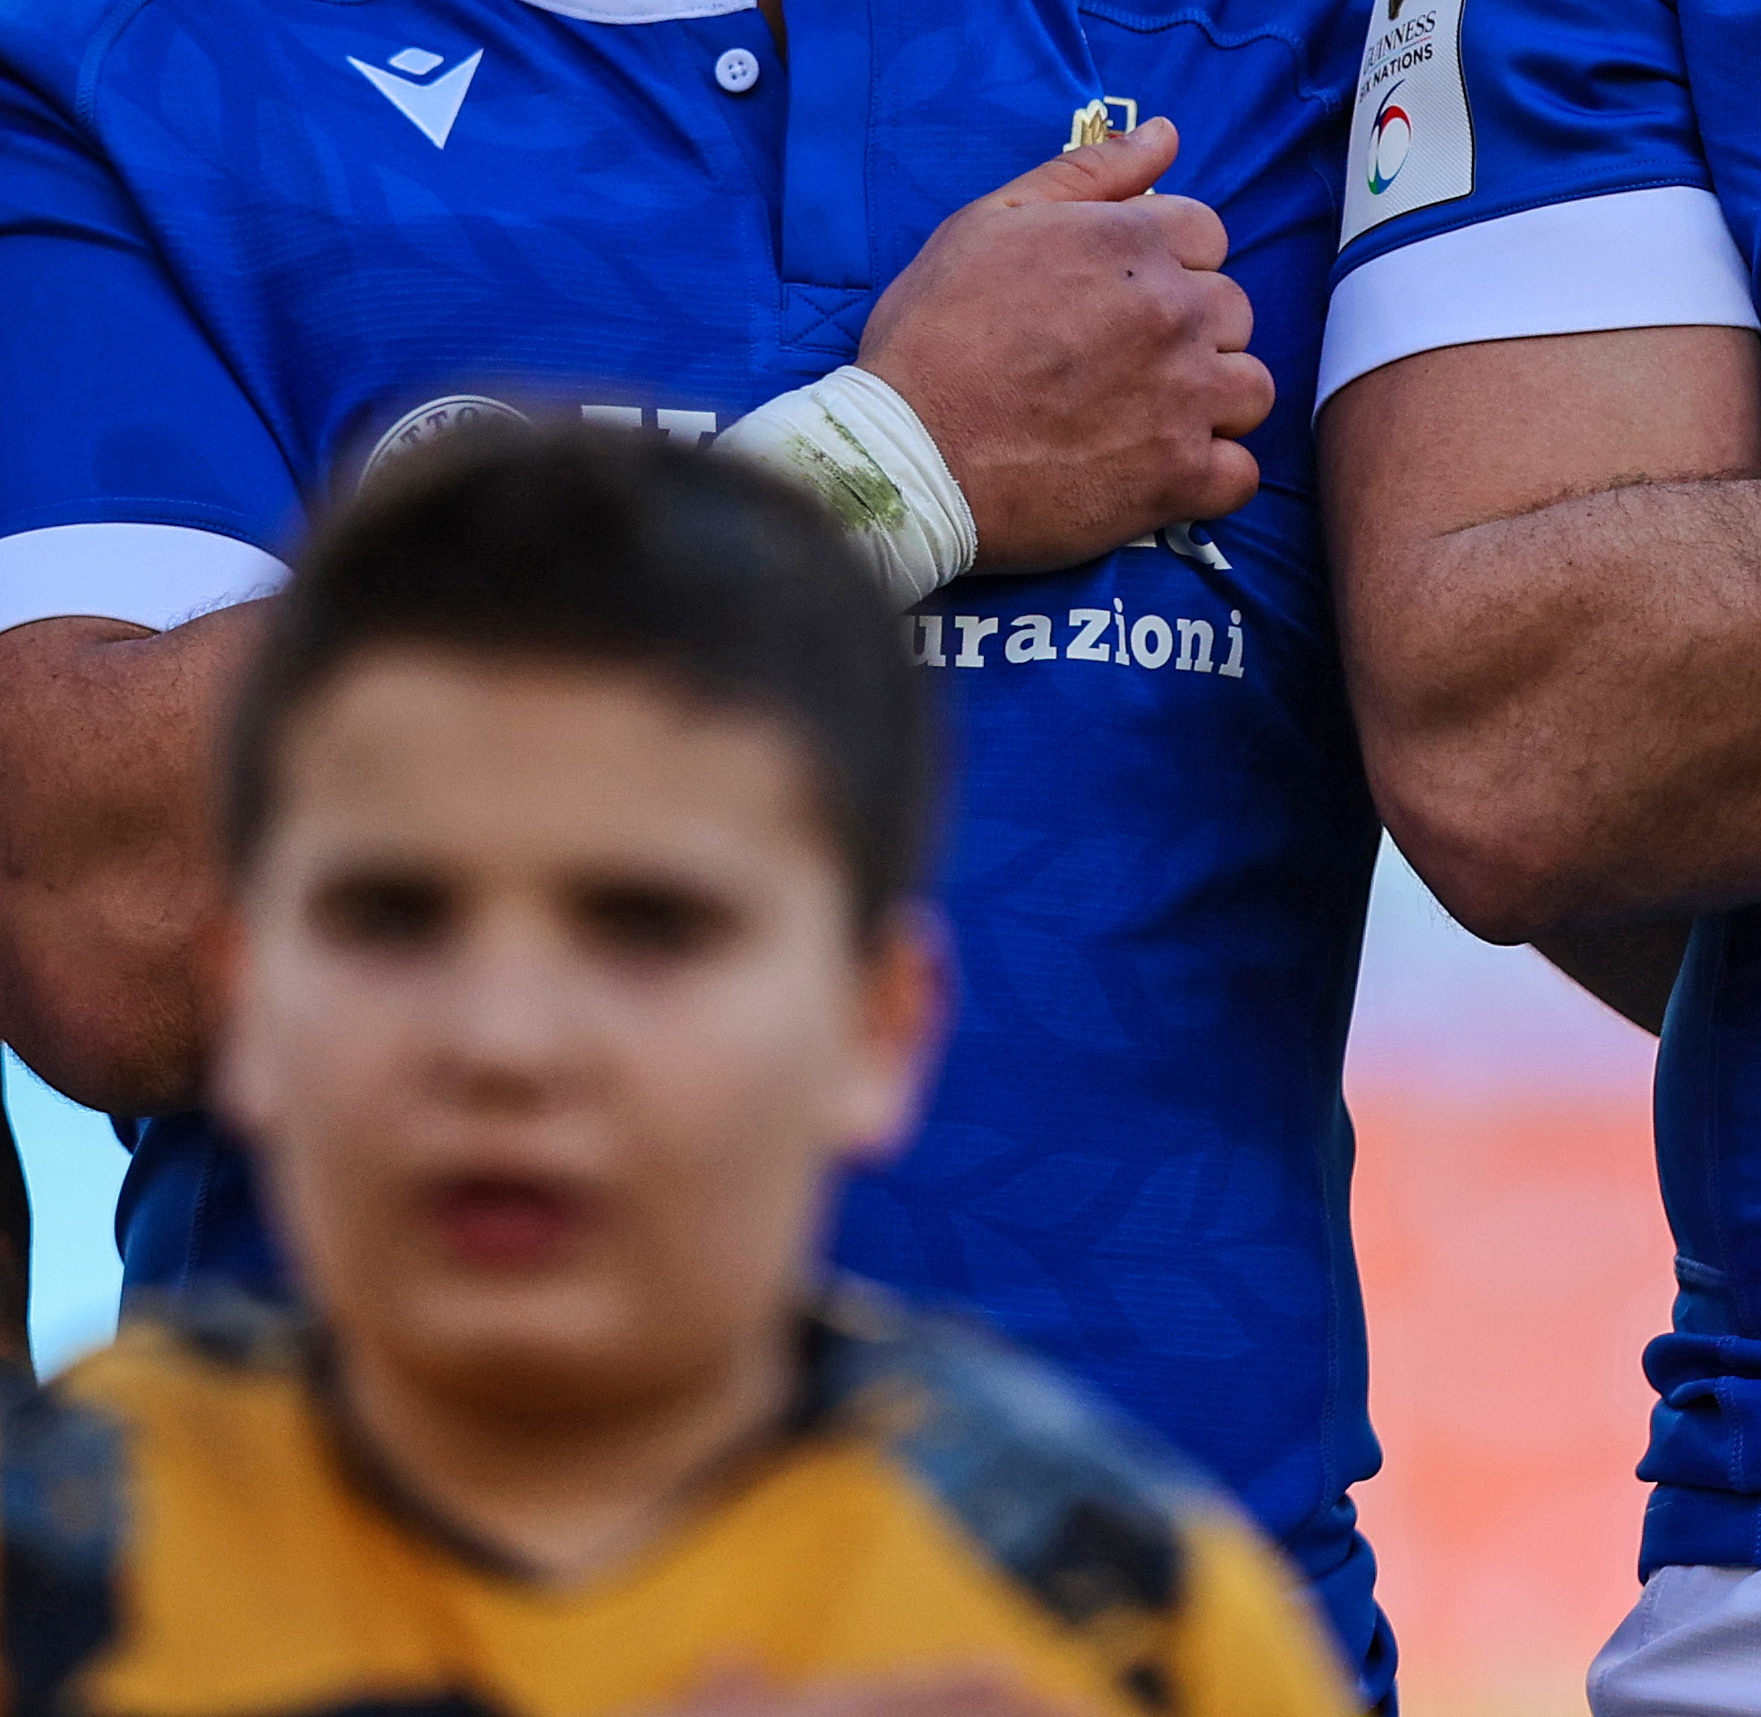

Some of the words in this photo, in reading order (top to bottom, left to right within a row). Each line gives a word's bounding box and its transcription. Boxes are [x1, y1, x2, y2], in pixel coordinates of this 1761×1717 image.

[1362, 10, 1437, 75] GUINNESS
[1373, 43, 1434, 87] NATIONS
[910, 597, 1245, 680] urazioni
